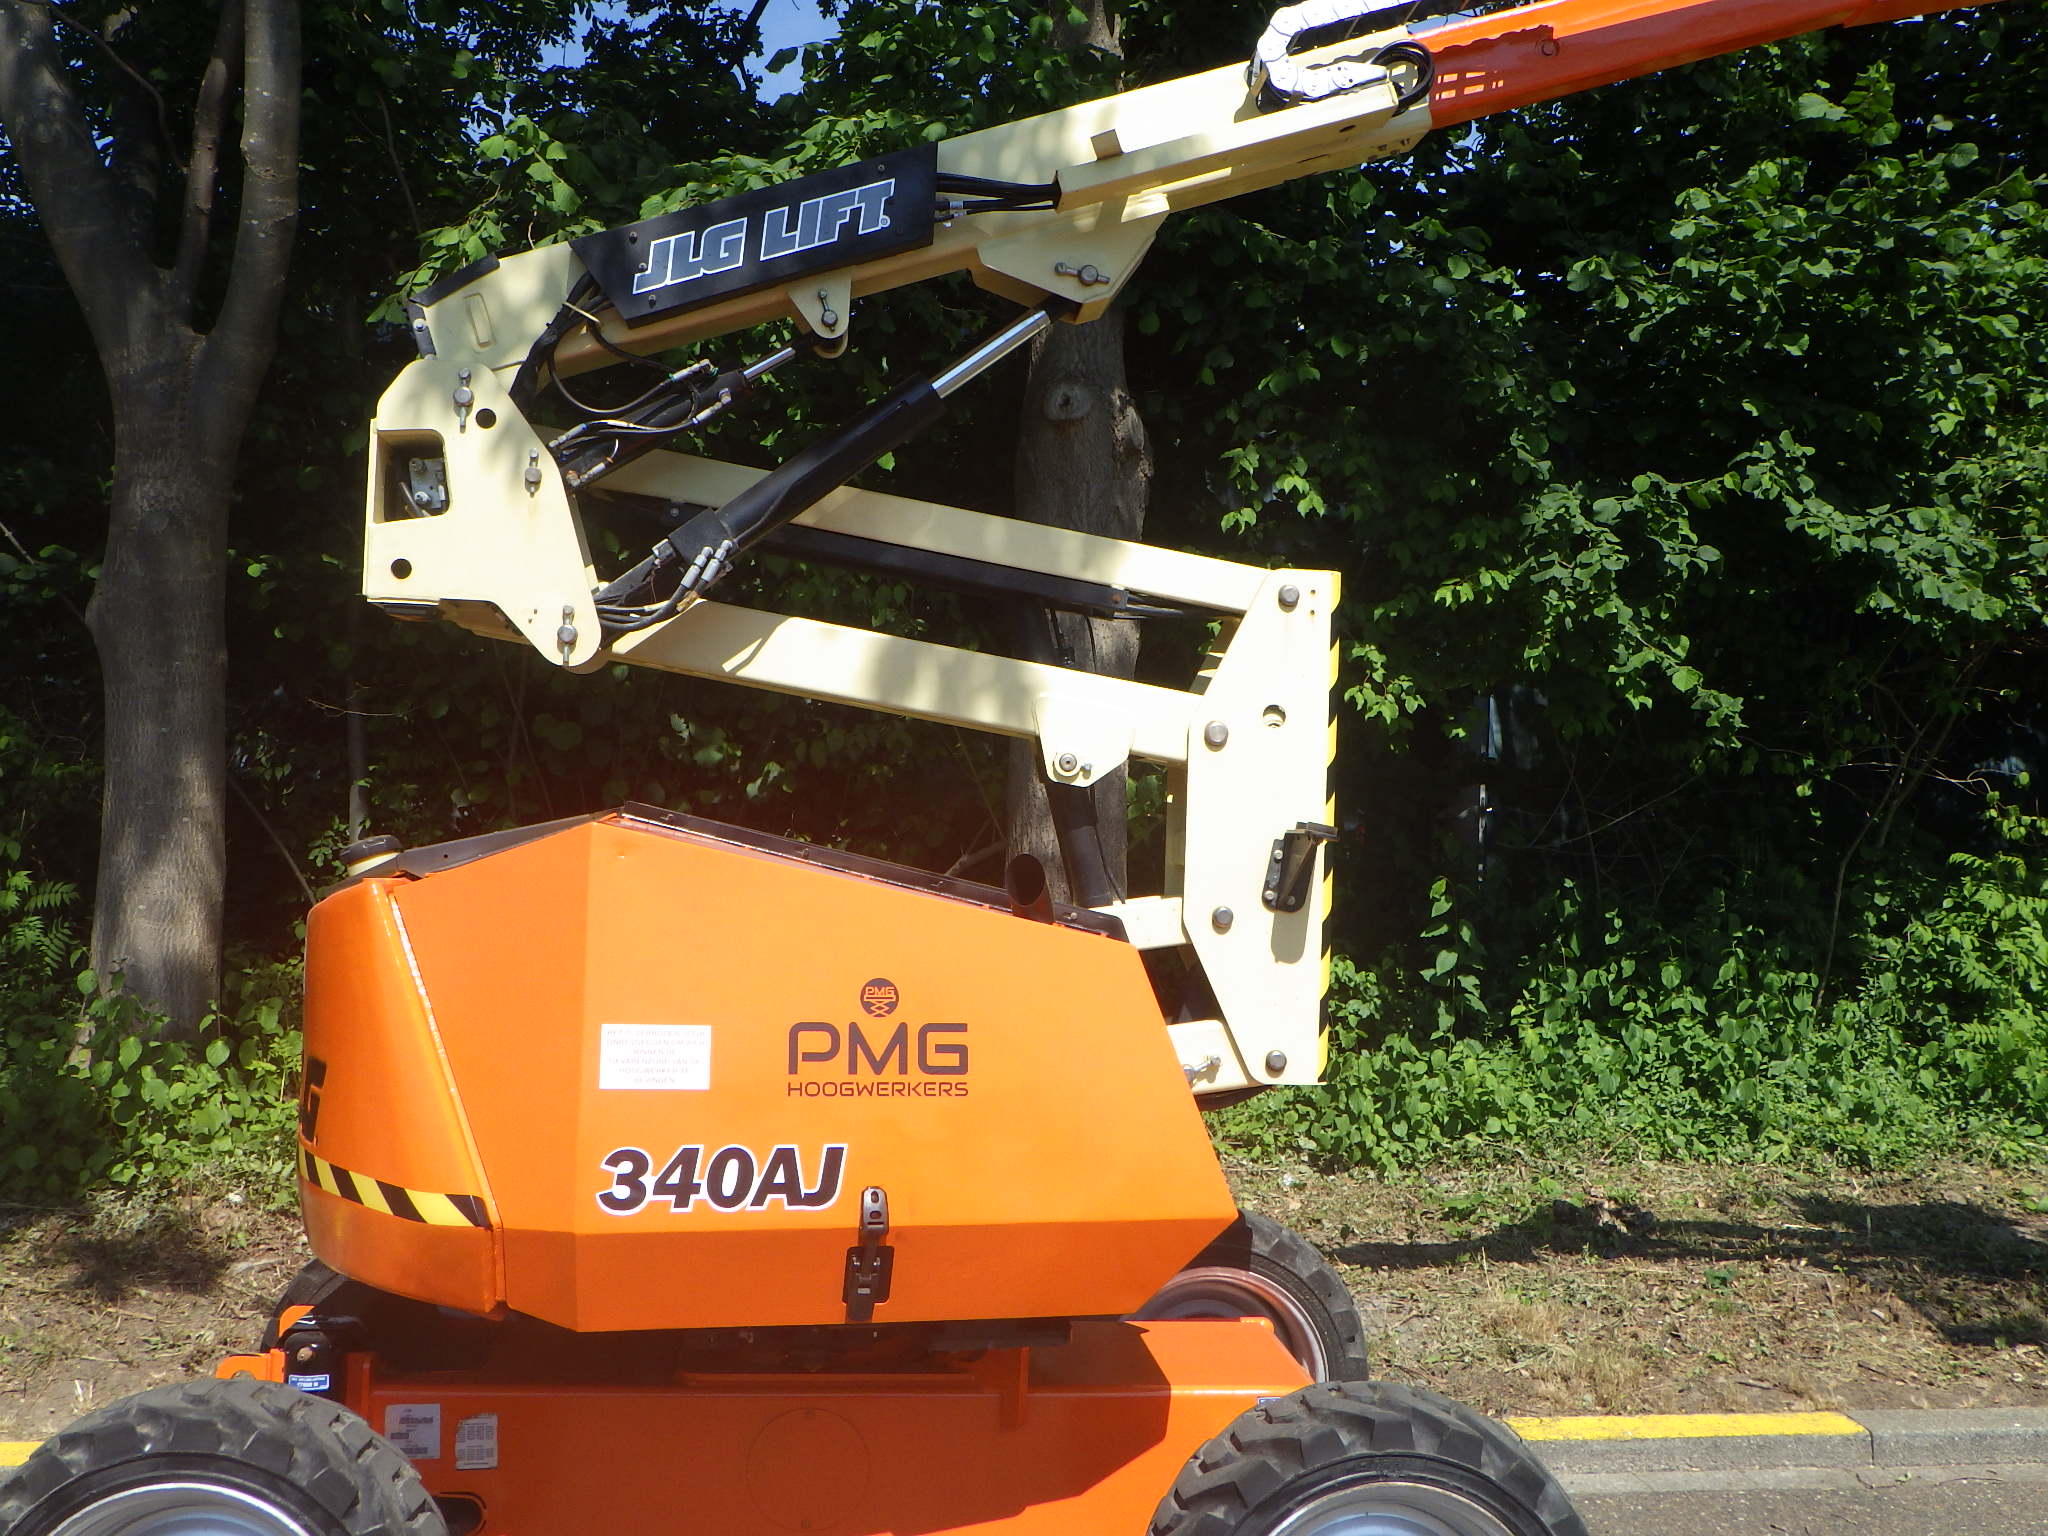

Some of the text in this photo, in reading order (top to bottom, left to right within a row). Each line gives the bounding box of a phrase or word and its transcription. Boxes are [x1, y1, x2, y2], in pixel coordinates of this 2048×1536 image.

[632, 178, 896, 295] JLG LIFT
[865, 986, 895, 996] PMG
[788, 1022, 969, 1075] PMG
[787, 1081, 969, 1097] HOOGWERKERS
[596, 1143, 848, 1216] 340AJ
